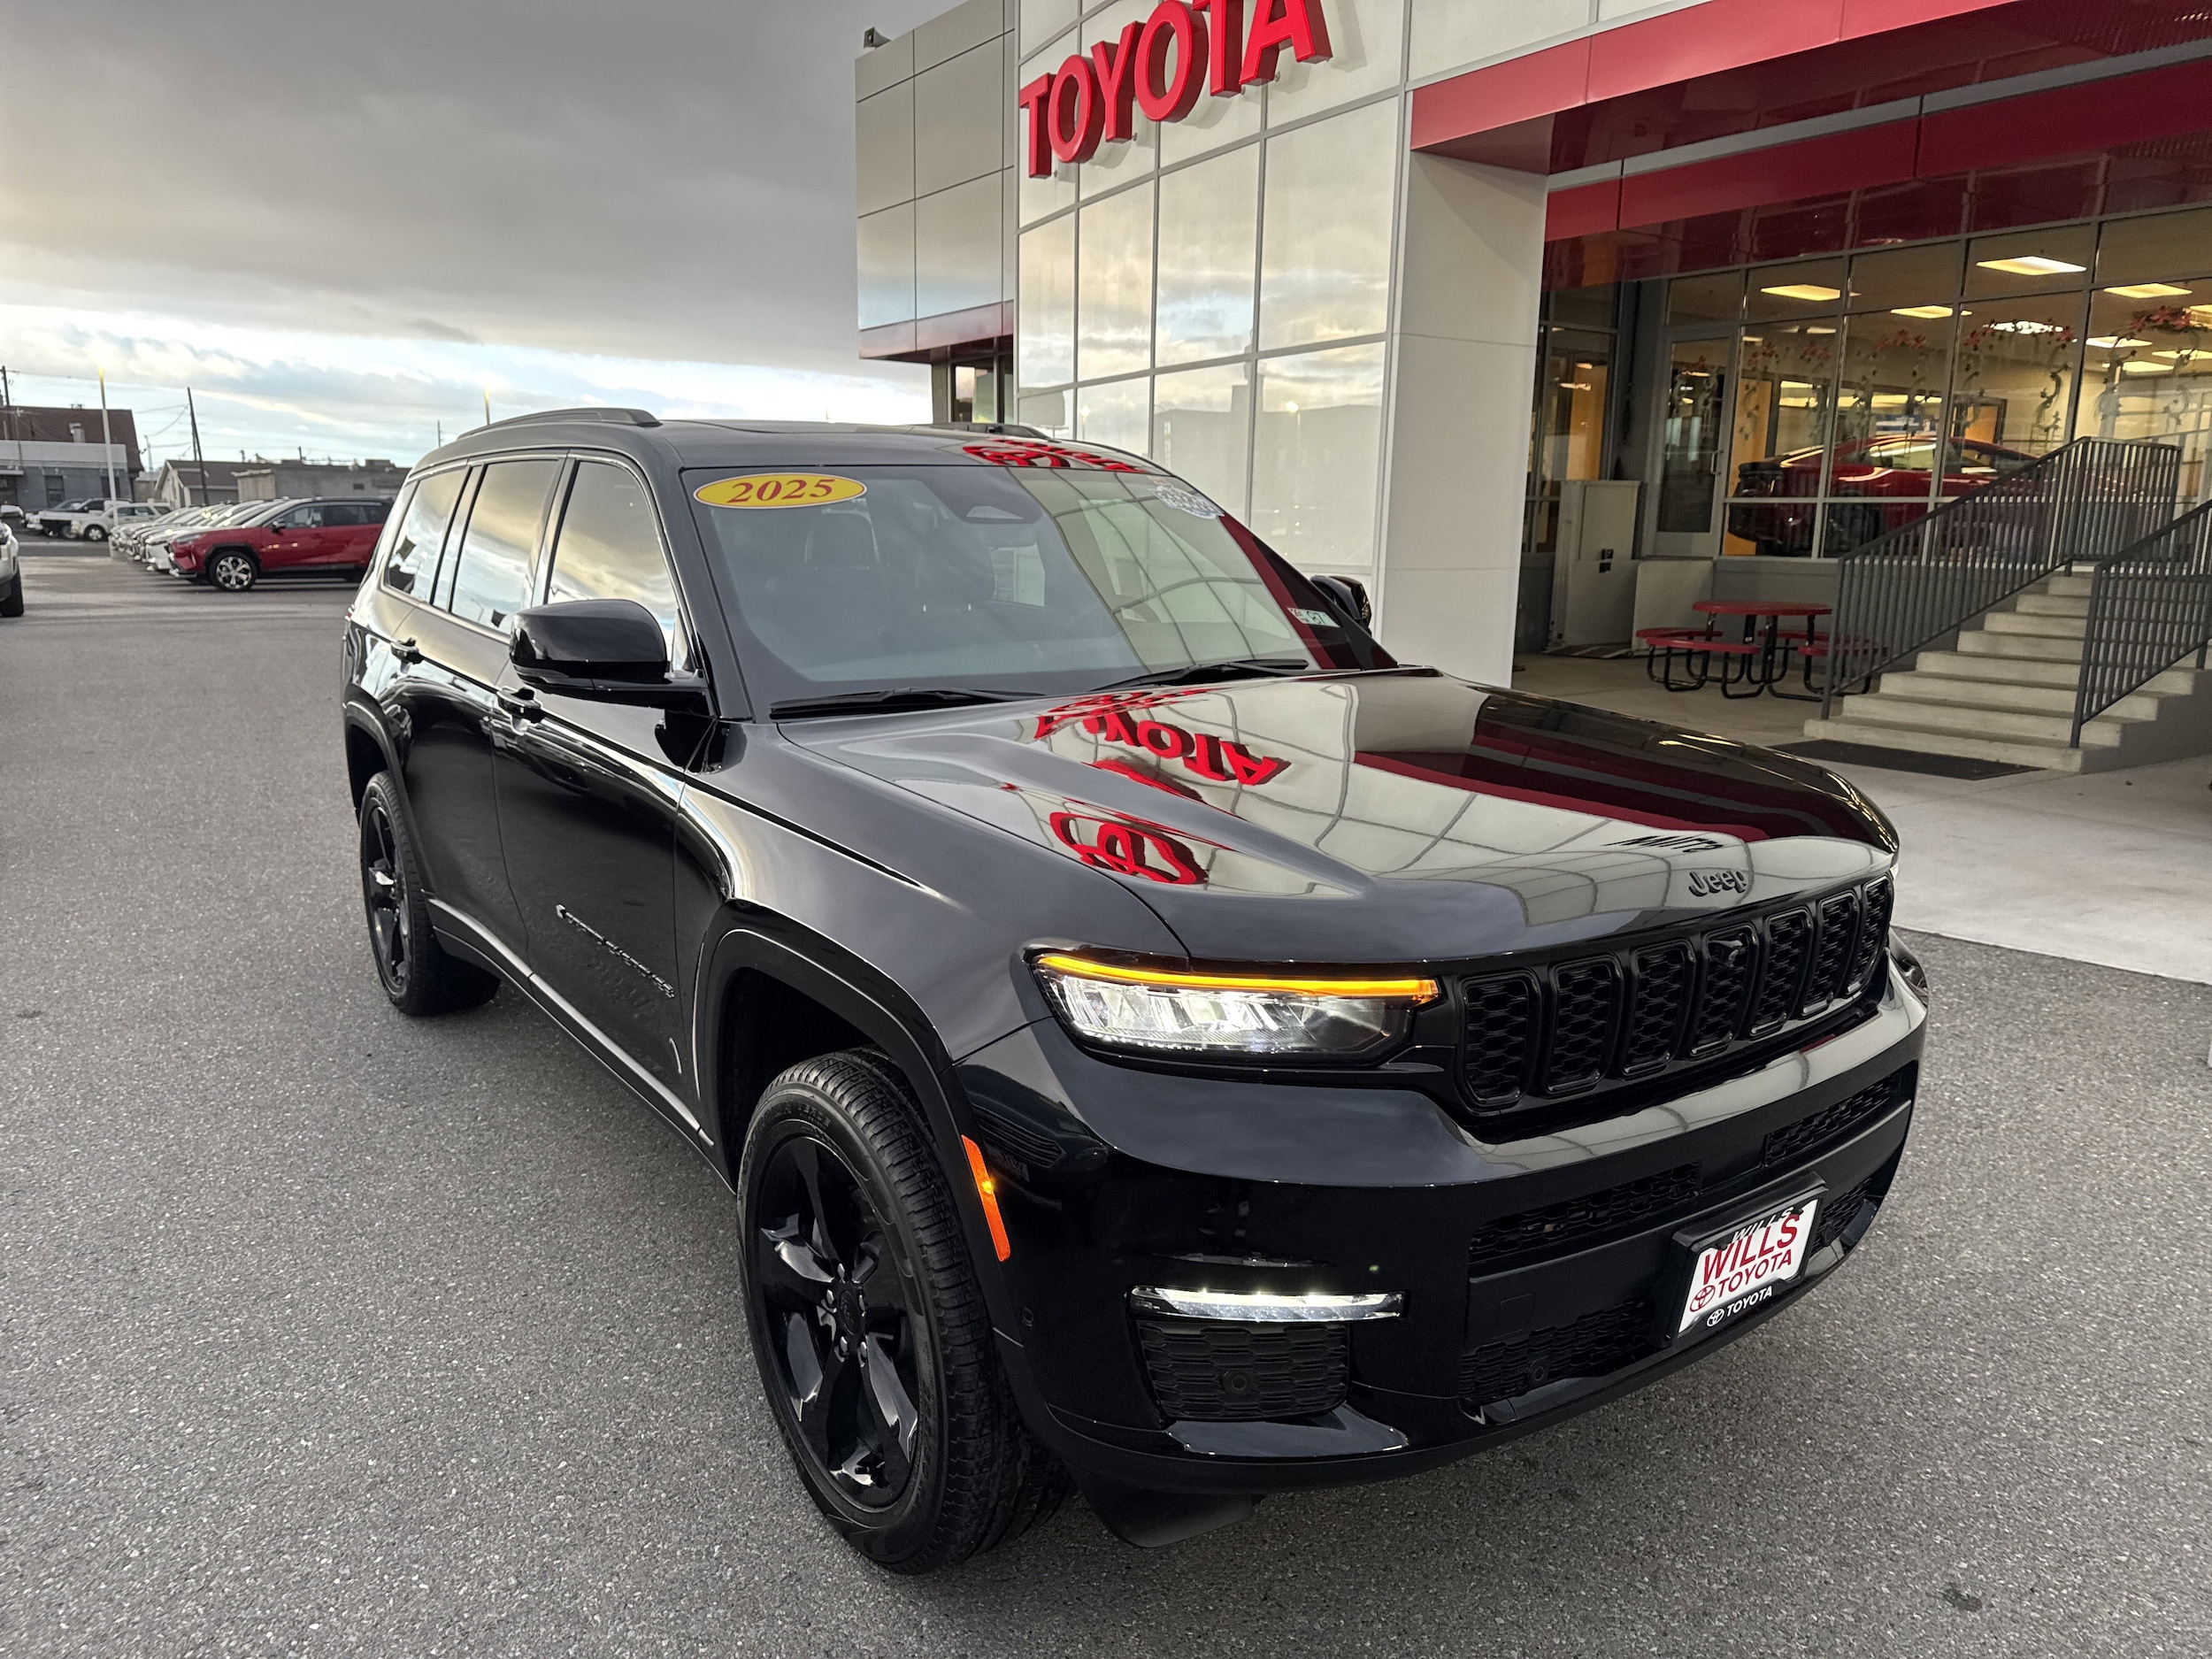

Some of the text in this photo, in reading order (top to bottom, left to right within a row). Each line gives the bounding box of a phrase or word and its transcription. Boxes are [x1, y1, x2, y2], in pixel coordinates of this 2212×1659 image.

[1019, 0, 1333, 179] TOYOTA
[727, 479, 835, 503] 2025
[1688, 870, 1747, 897] Jeep
[1703, 1213, 1800, 1286] WILLS
[1718, 1248, 1792, 1298] TOYOTA
[1726, 1286, 1773, 1317] TOYOTA
